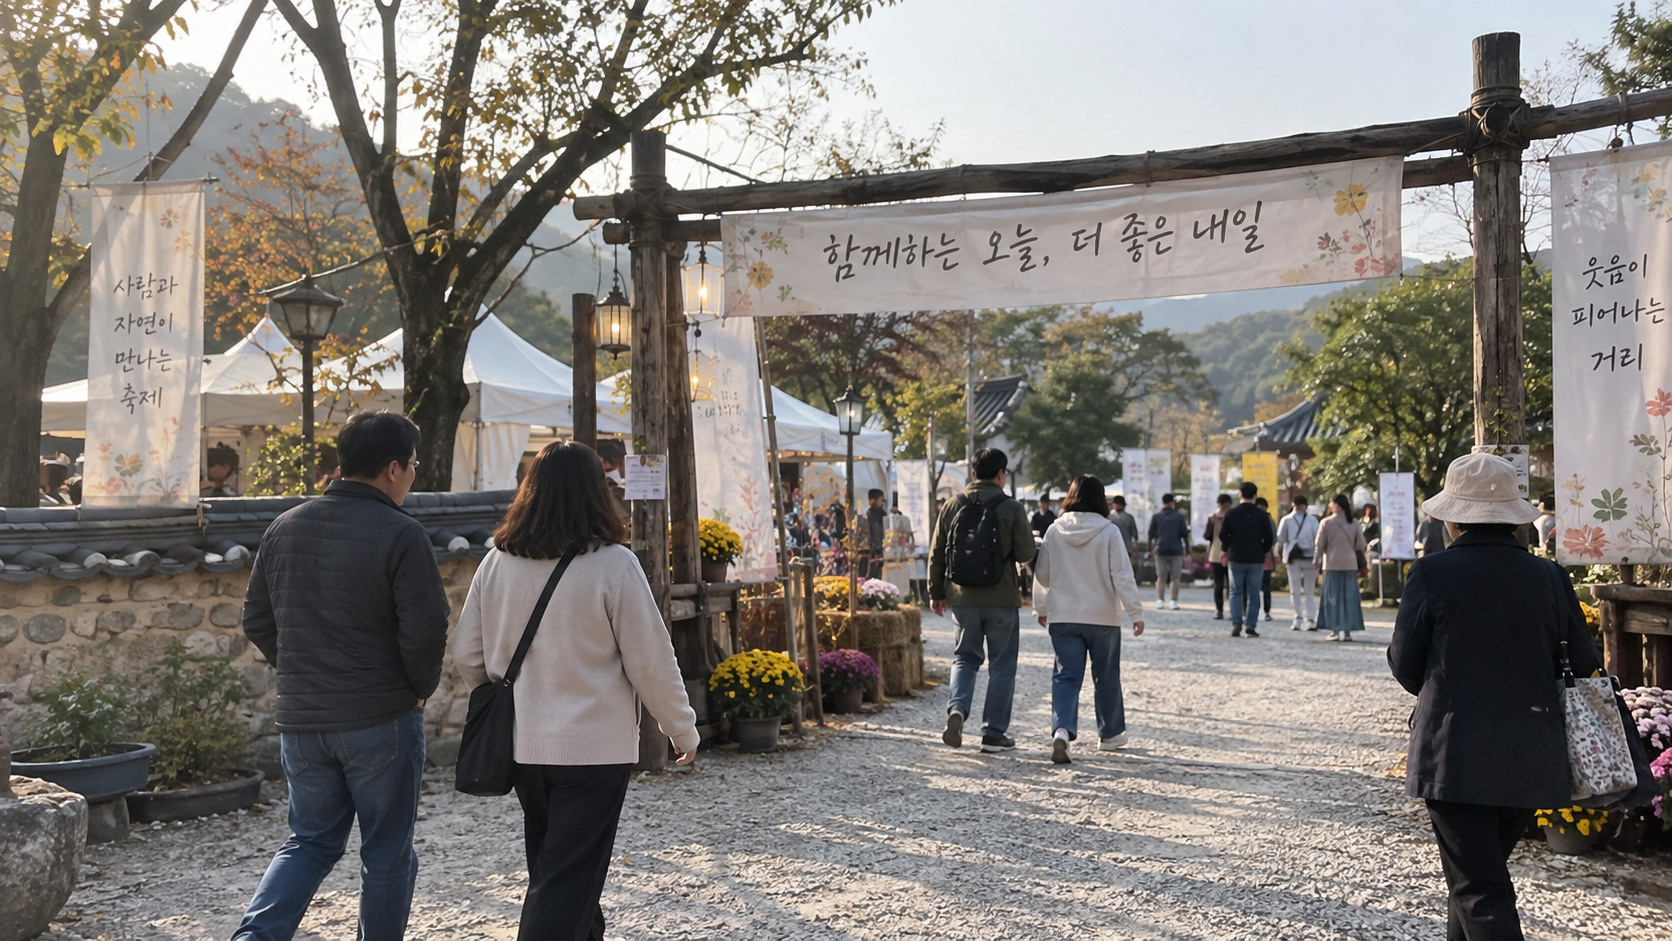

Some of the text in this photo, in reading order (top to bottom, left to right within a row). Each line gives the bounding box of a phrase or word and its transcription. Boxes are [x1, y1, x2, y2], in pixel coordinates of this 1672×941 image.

[822, 199, 1265, 283] 함께하는 오늘, 더 좋은 내일
[113, 272, 179, 300] 사람과
[1582, 253, 1648, 290] 웃음이
[113, 311, 173, 336] 자연이
[1571, 297, 1666, 328] 피어나는
[114, 347, 173, 373] 만나는
[1590, 342, 1643, 373] 거리
[120, 382, 163, 415] 축제
